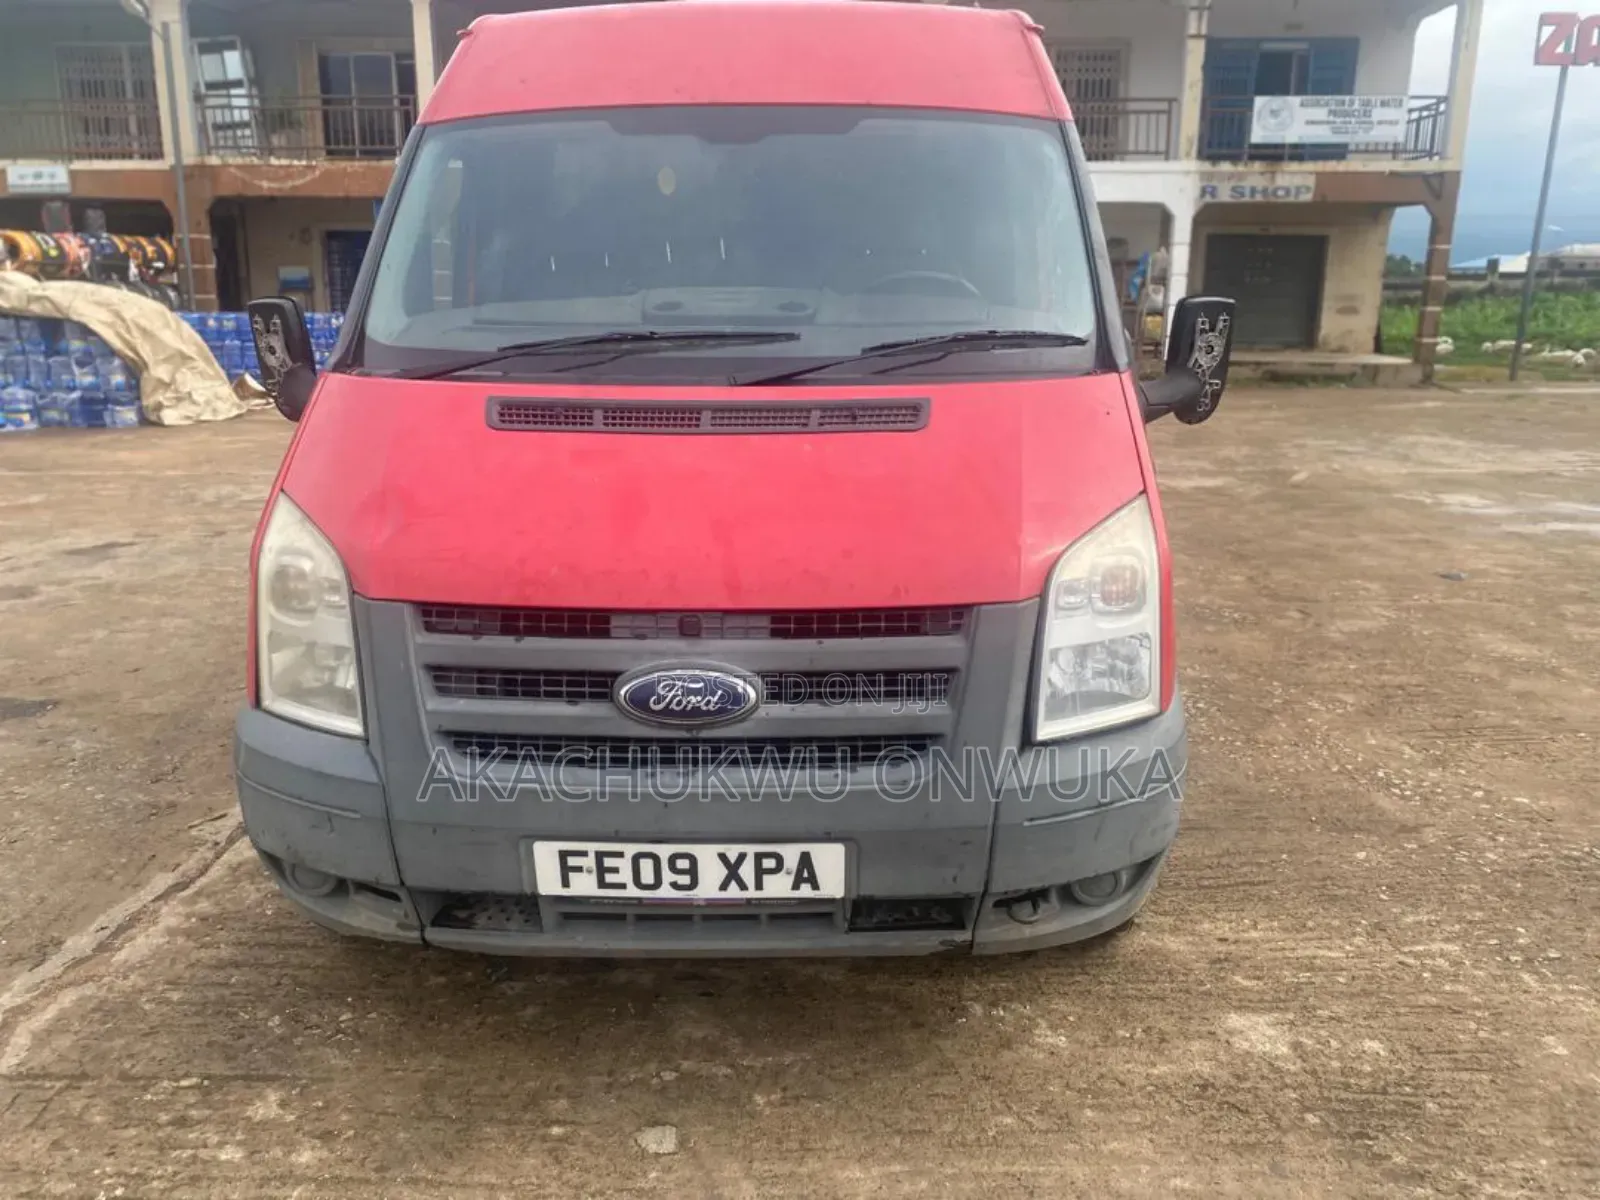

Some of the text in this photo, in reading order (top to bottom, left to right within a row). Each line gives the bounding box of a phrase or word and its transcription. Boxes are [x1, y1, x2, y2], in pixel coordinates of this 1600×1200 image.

[1229, 184, 1313, 200] SHOP
[649, 681, 723, 711] Ford
[558, 850, 821, 892] FE09 XPA
